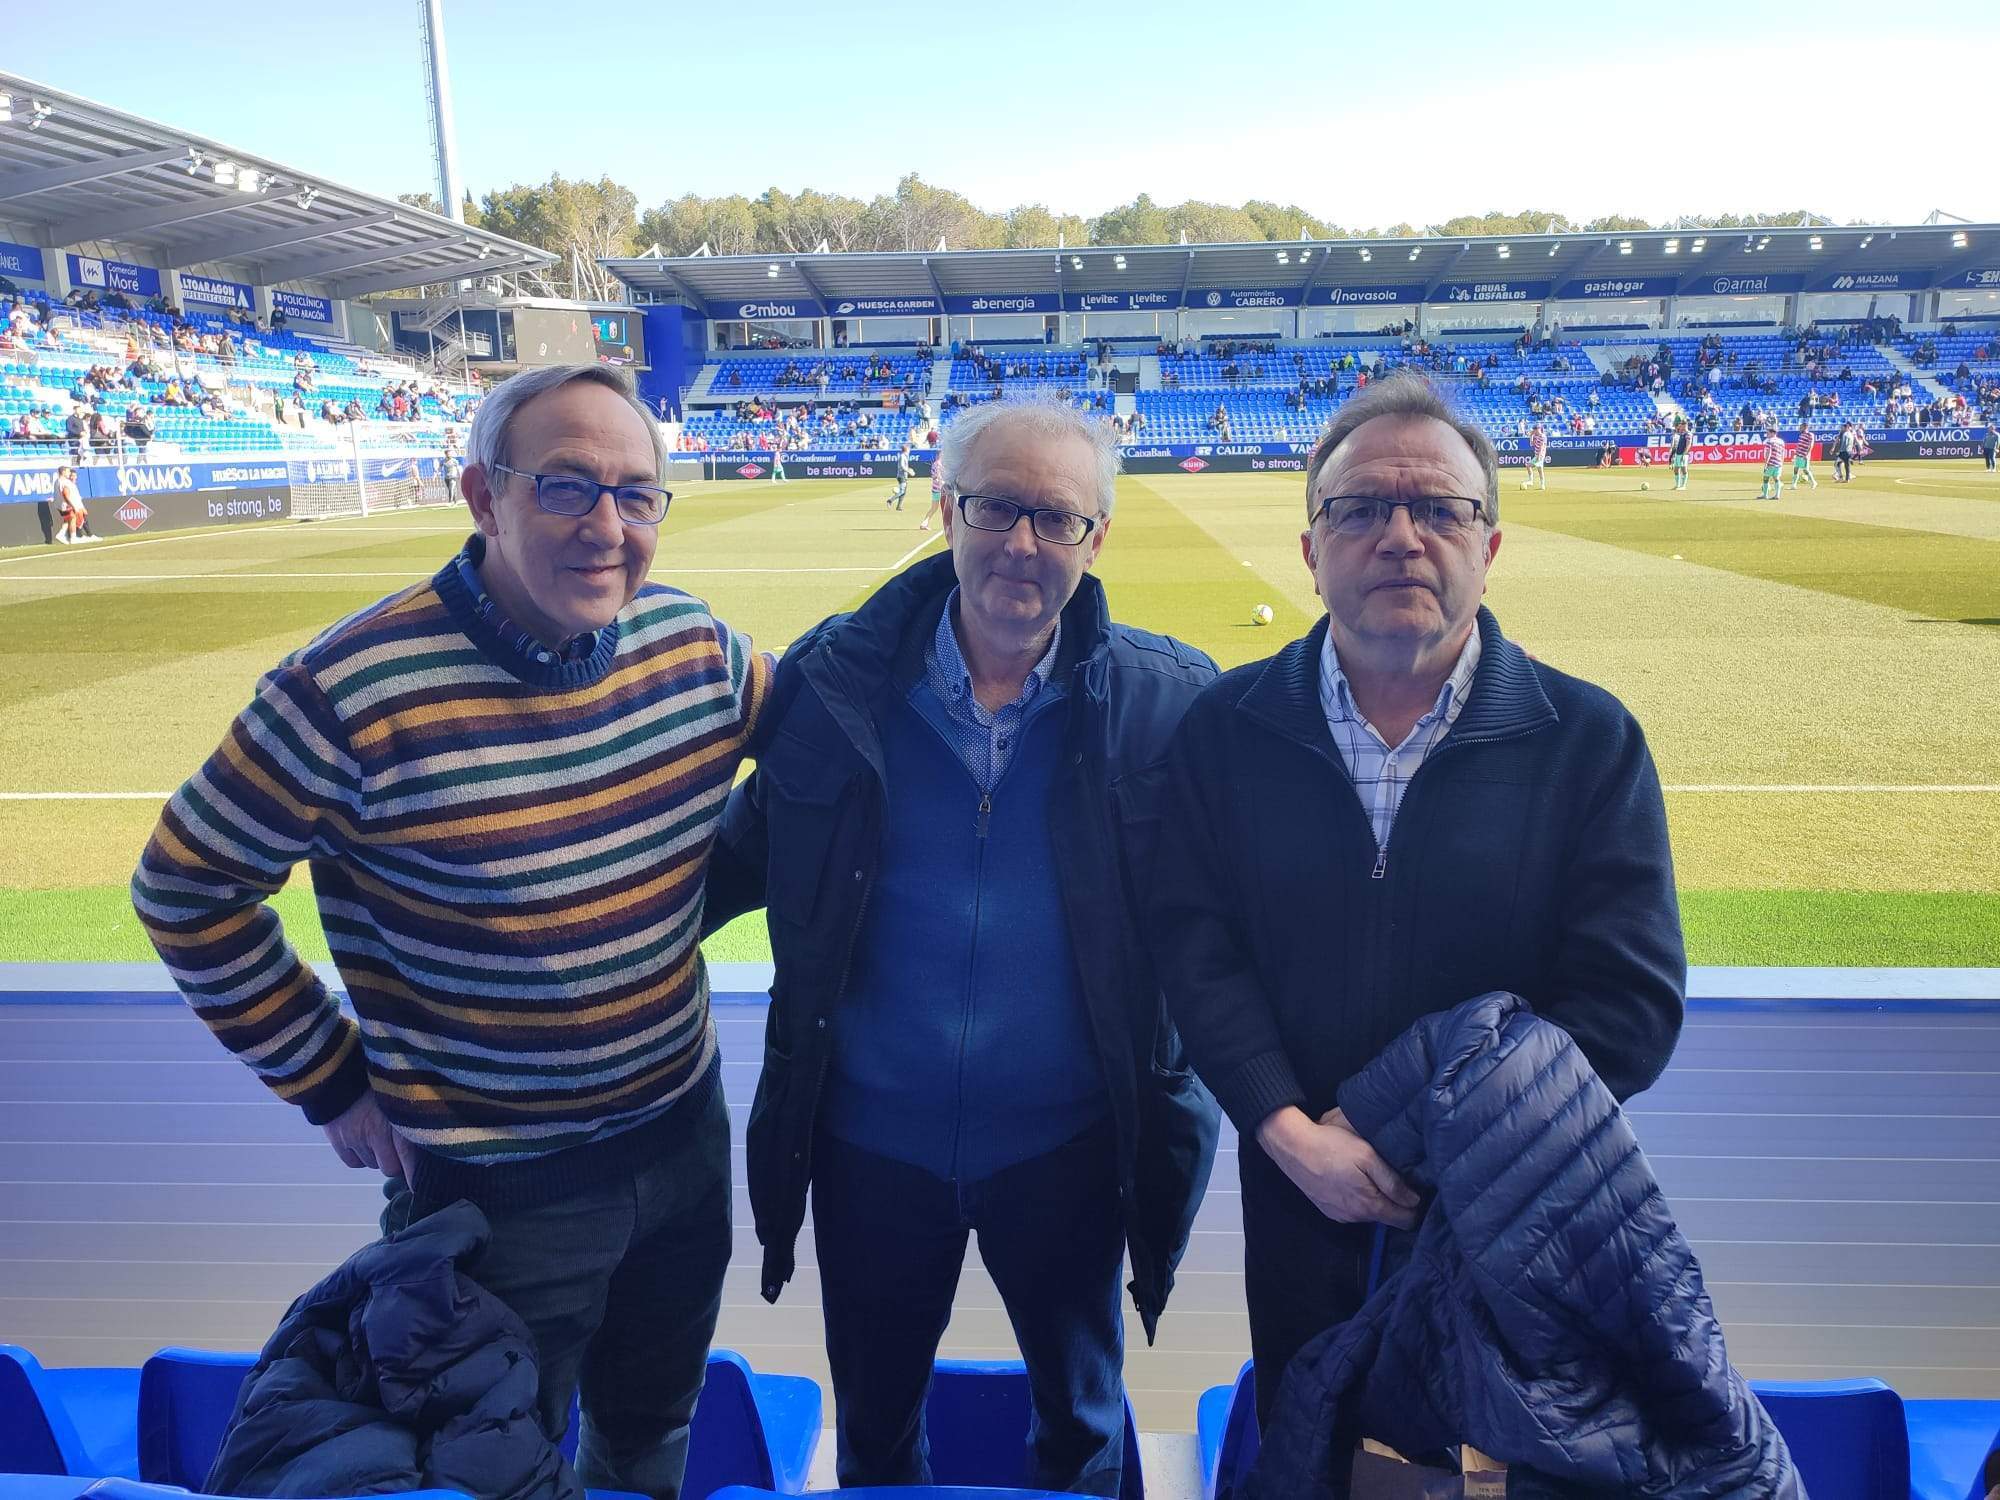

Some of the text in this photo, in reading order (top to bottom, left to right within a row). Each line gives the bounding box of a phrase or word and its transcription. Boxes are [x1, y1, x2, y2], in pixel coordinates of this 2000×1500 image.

[107, 263, 138, 276] Comercial
[109, 272, 140, 291] Moré
[1730, 276, 1769, 290] arnal
[1856, 274, 1899, 284] MAZANA
[1230, 290, 1275, 298] Automóviles
[1474, 283, 1507, 292] GRUAS
[183, 290, 236, 305] UPERMERCADOS
[282, 294, 324, 309] POLICLÍNICA
[1235, 297, 1285, 307] CABRERO
[1342, 290, 1397, 302] navasola
[739, 302, 796, 318] embou
[857, 300, 935, 310] HUESCA GARDEN
[284, 307, 326, 320] ALTO ARAGÓN
[1647, 432, 1768, 448] EL LCORA
[1905, 429, 1970, 443] SOMMOS
[1126, 447, 1172, 458] CaixaBank
[1216, 445, 1262, 455] CALLIZO
[1919, 446, 1932, 456] be
[1935, 446, 1974, 458] strong,
[1252, 458, 1304, 471] be strong,
[806, 465, 873, 478] be strong, be
[119, 506, 149, 521] KUHN
[208, 496, 282, 519] be strong, be
